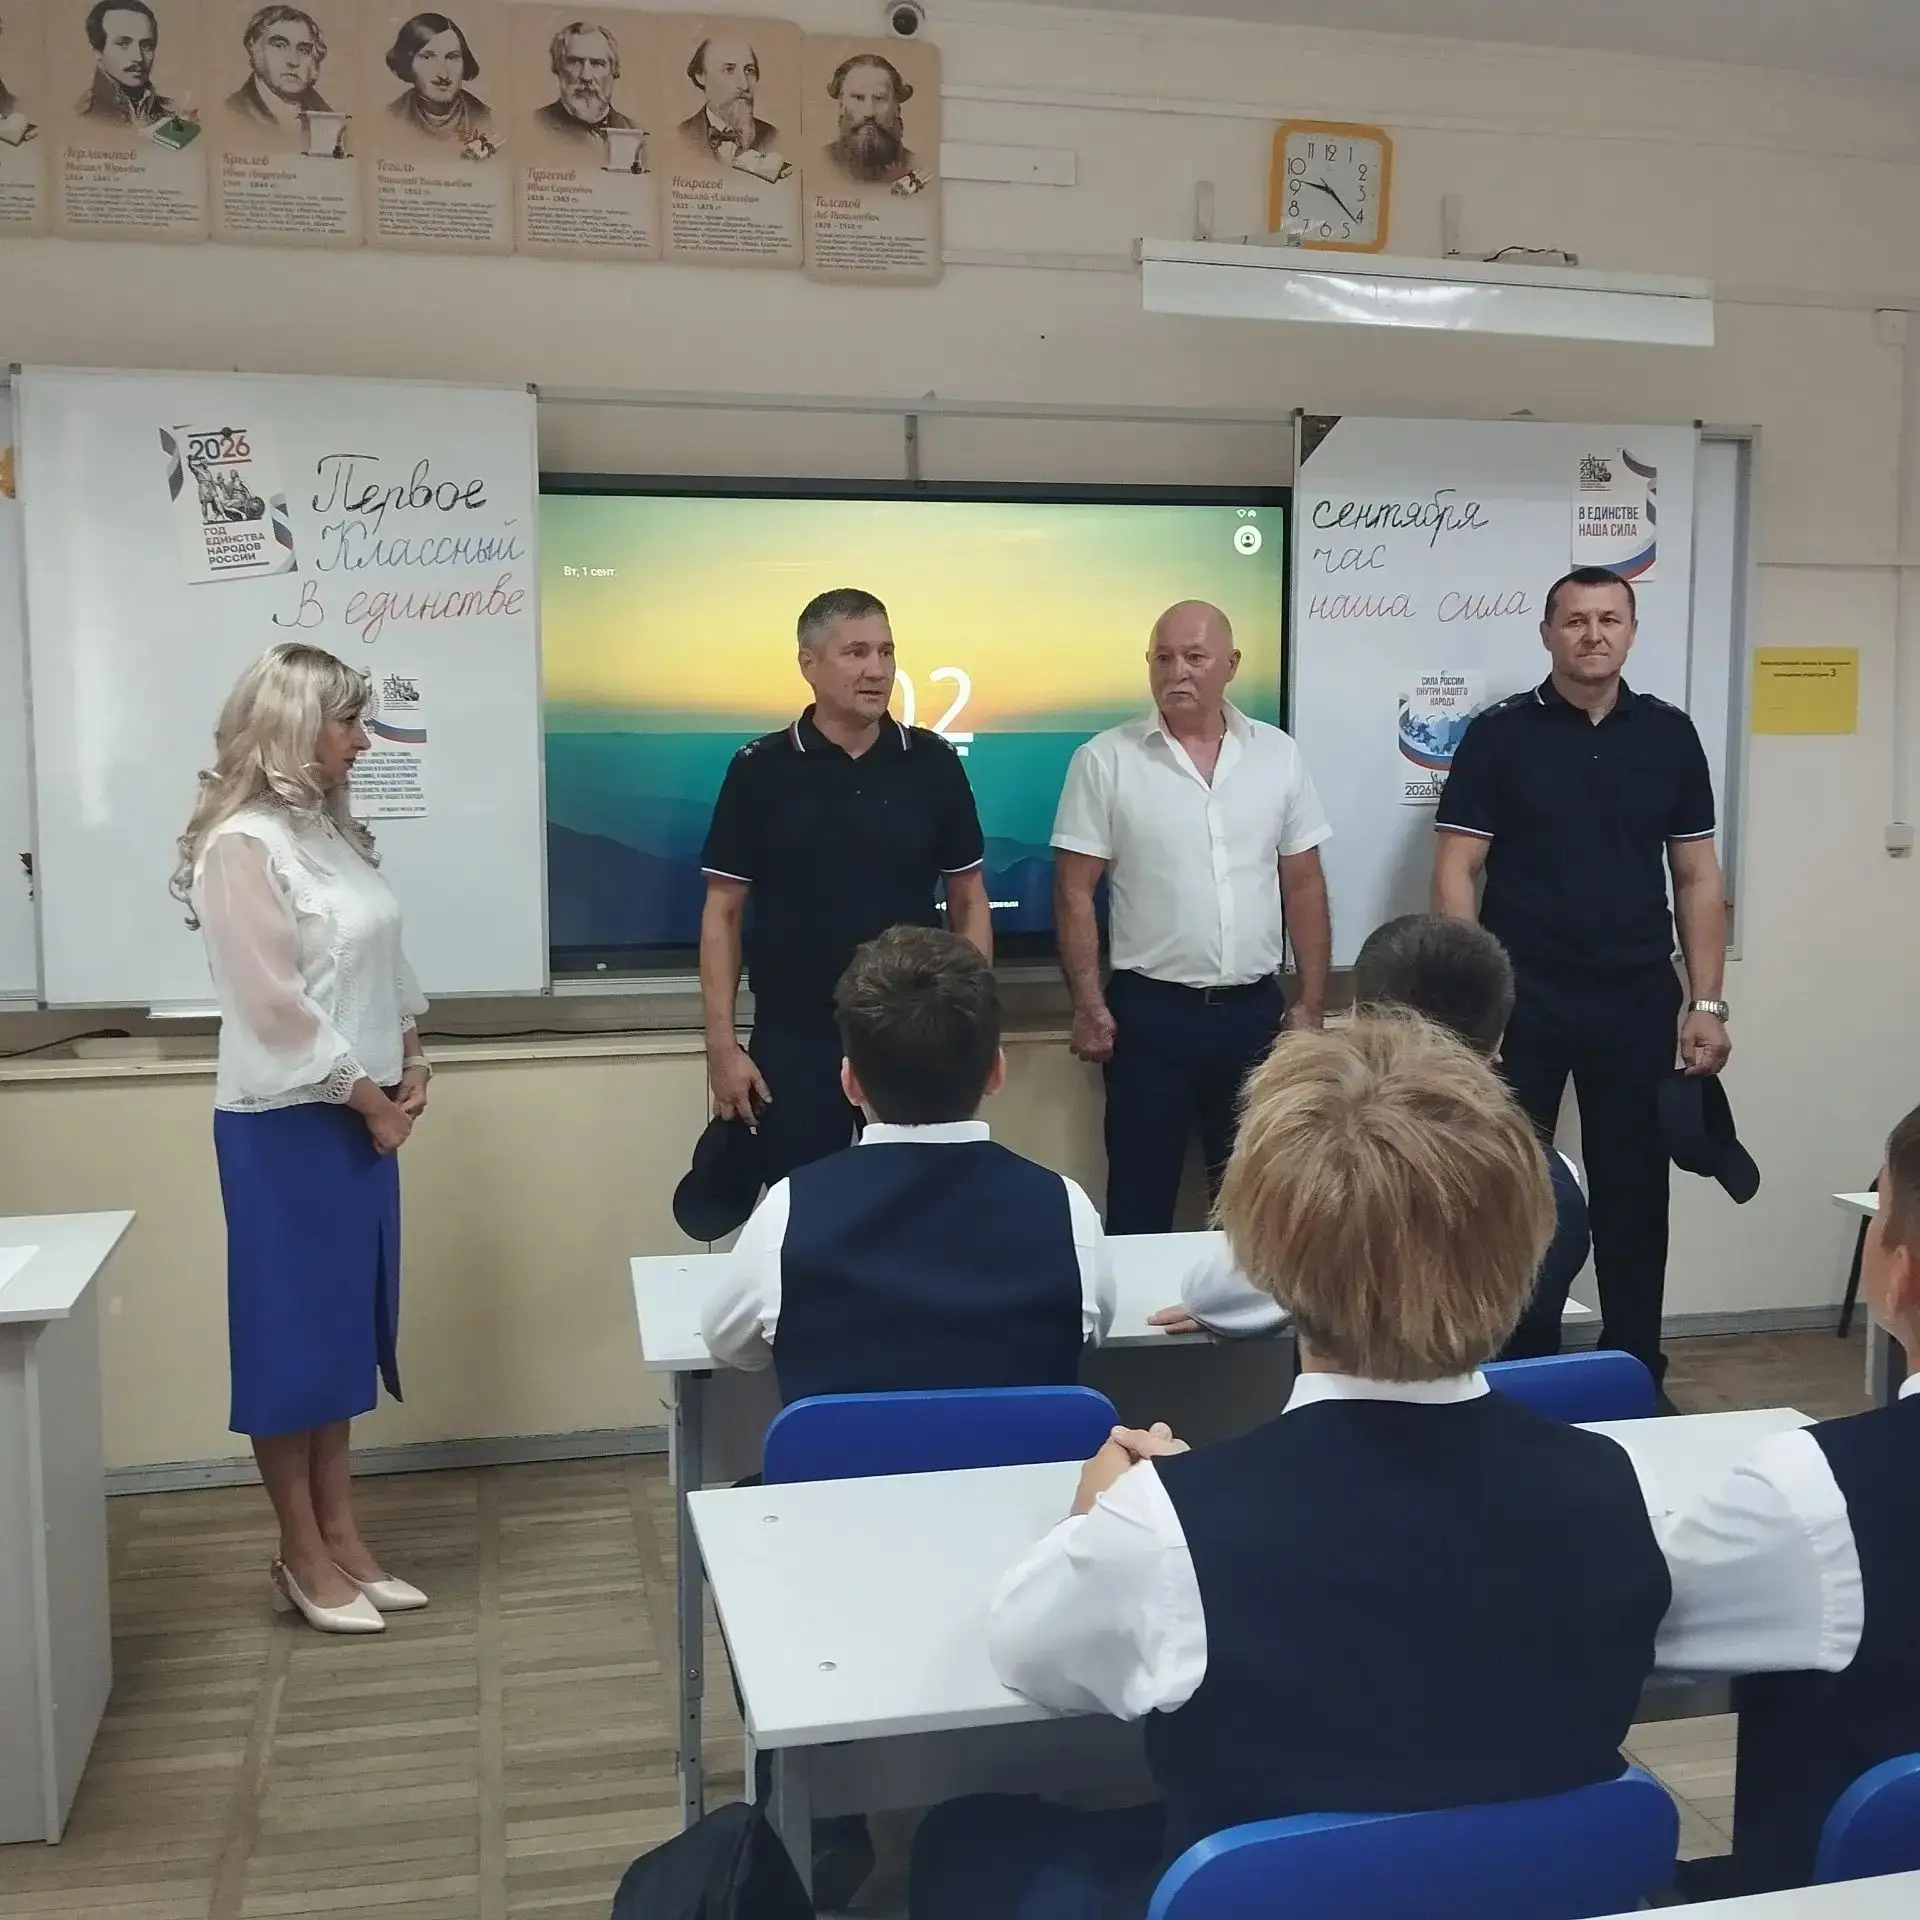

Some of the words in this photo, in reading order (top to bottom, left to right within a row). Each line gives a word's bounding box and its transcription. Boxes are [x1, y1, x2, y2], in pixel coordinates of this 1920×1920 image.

[1308, 142, 1315, 159] 11
[1325, 144, 1337, 161] 12
[1348, 146, 1353, 164] 1
[526, 167, 576, 182] Тургенев
[1288, 157, 1306, 175] 10
[1358, 164, 1367, 181] 2
[672, 175, 723, 190] Некрасов
[1289, 178, 1301, 195] 9
[815, 195, 861, 209] Толстой
[1357, 185, 1366, 202] 3
[1288, 200, 1299, 217] 8
[1356, 207, 1364, 223] 4
[1303, 218, 1310, 232] 7
[1320, 220, 1332, 237] 6
[1341, 222, 1350, 239] 5
[188, 435, 251, 461] 2026
[312, 453, 487, 534] Первое
[1312, 488, 1489, 548] сентября
[1578, 506, 1585, 520] В
[1588, 506, 1639, 521] ЕДИНСТВЕ
[203, 526, 227, 536] ГОД
[1579, 523, 1608, 537] НАША
[1611, 523, 1637, 537] СИЛА
[206, 532, 266, 546] ЕДИНСТВА
[316, 518, 525, 572] Классный
[207, 543, 262, 556] НАРОДОВ
[209, 552, 256, 565] РОССИИ
[1313, 544, 1386, 573] час
[564, 565, 580, 578] Вт,
[582, 566, 588, 577] 1
[272, 579, 325, 627] В
[345, 572, 525, 643] единстве
[1308, 592, 1417, 619] наша
[1421, 676, 1439, 686] СИЛА
[1440, 676, 1465, 686] РОССИИ
[1416, 687, 1440, 696] ВНУТРИ
[1442, 687, 1468, 696] НАШЕГО
[1430, 697, 1455, 706] НАРОДА
[1405, 785, 1432, 796] 2026
